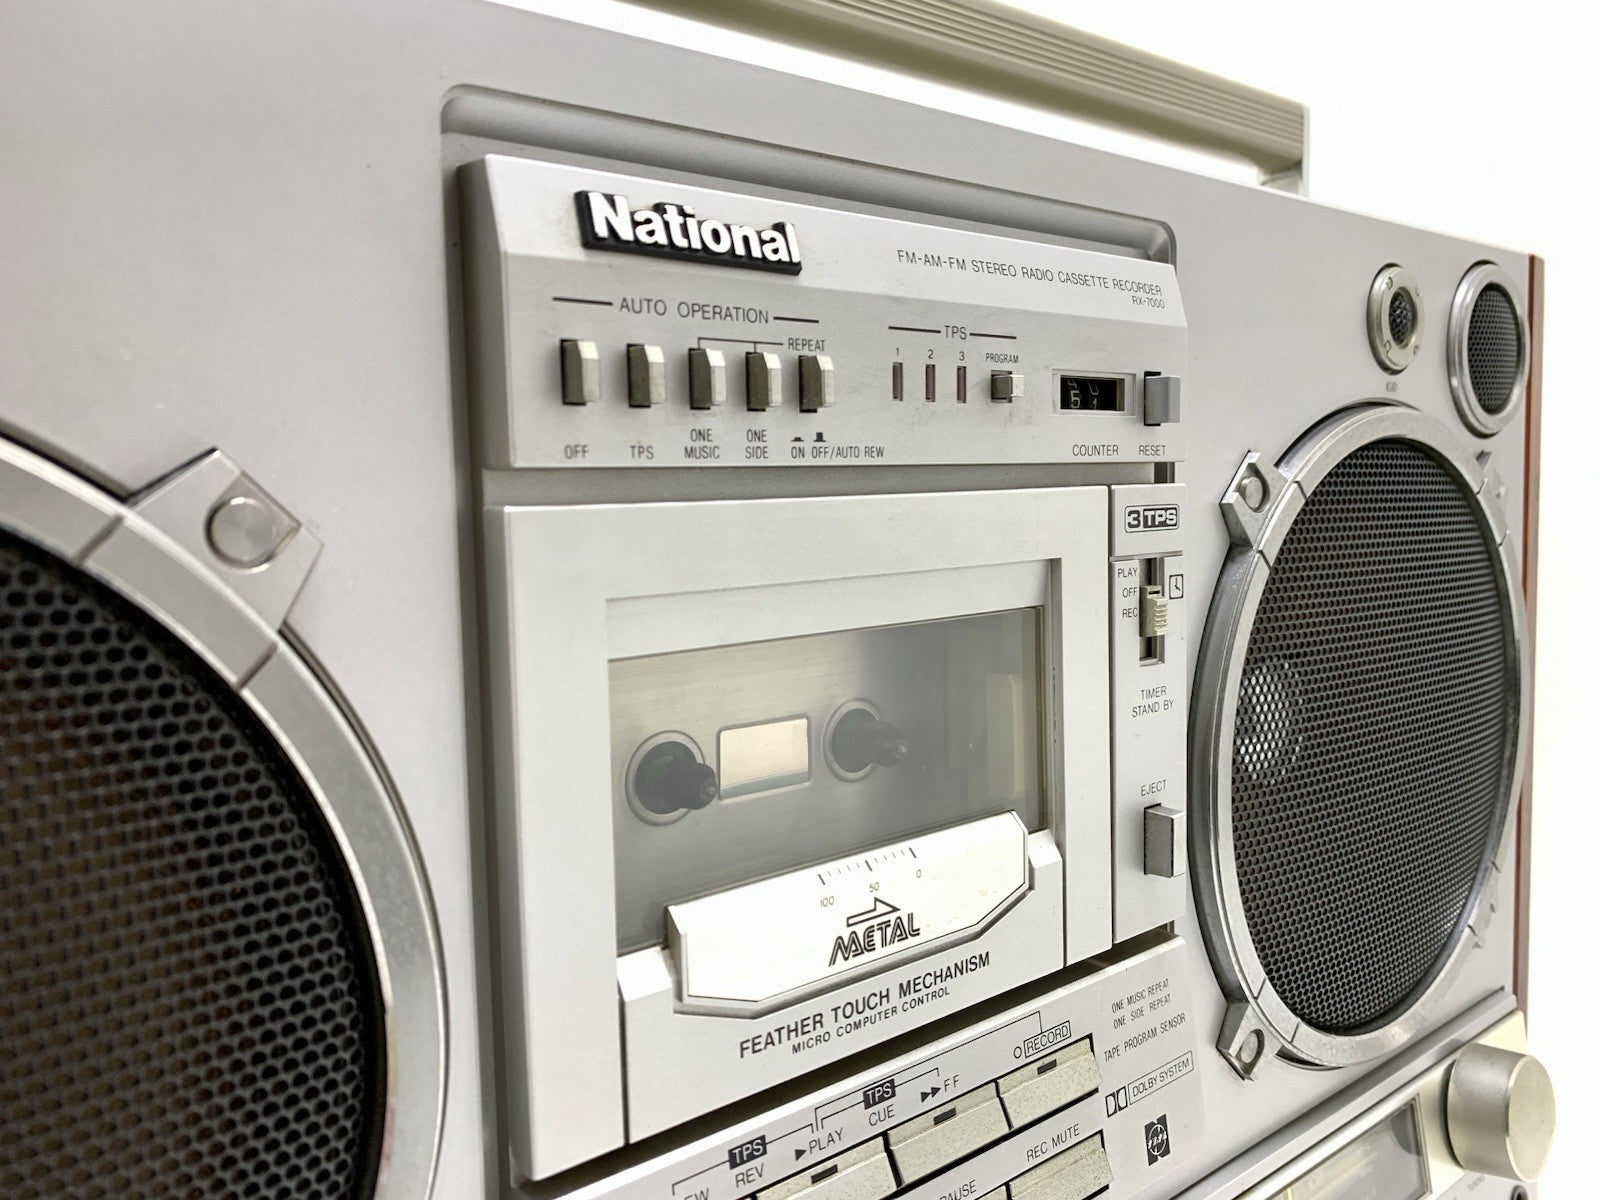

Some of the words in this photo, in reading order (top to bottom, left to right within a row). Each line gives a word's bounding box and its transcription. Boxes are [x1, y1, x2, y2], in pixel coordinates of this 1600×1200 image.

[588, 192, 801, 263] National
[897, 249, 967, 271] FM-AM-FM
[971, 259, 1017, 277] STEREO
[1021, 266, 1054, 282] RADIO
[1057, 271, 1110, 290] CASSETTE
[1112, 278, 1163, 295] RECORDER
[619, 297, 667, 316] AUTO
[676, 301, 769, 325] OPERATION
[1131, 295, 1166, 309] RX-7000
[944, 324, 968, 340] TPS
[787, 337, 826, 352] REPEAT
[895, 347, 900, 357] 1
[927, 349, 934, 360] 2
[958, 351, 966, 362] 3
[985, 352, 1019, 364] PROGRAM
[690, 428, 714, 443] ONE
[746, 429, 768, 443] ONE
[563, 444, 591, 460] OFF
[629, 445, 655, 460] TPS
[684, 445, 721, 460] MUSIC
[744, 446, 769, 460] SIDE
[790, 446, 806, 460] ON
[864, 446, 886, 459] REW
[1071, 444, 1119, 457] COUNTER
[1138, 445, 1166, 457] RESET
[1144, 508, 1177, 526] TPS
[1117, 567, 1138, 579] PLAY
[1122, 587, 1138, 599] OFF
[1122, 608, 1138, 619] REC
[1140, 686, 1167, 701] TIMER
[1131, 704, 1162, 719] STAND
[1163, 700, 1175, 712] BY
[1140, 779, 1168, 797] EJECT
[819, 896, 835, 909] 100
[868, 881, 881, 894] 50
[916, 870, 923, 880] 0
[828, 912, 921, 967] METAL
[739, 1013, 824, 1058] FEATHER
[830, 987, 890, 1024] TOUCH
[899, 950, 991, 999] MECHANISM
[1111, 1002, 1124, 1014] ONE
[1126, 988, 1146, 1005] MUSIC
[1147, 978, 1170, 996] REPEAT
[1113, 1016, 1127, 1030] ONE
[1130, 1007, 1145, 1022] SIDE
[1149, 993, 1171, 1013] REPEAT
[791, 1032, 831, 1055] MICRO
[836, 1007, 899, 1039] COMPUTER
[901, 987, 951, 1014] CONTROL
[1026, 1025, 1069, 1054] RECORD
[1103, 1044, 1121, 1063] TAPE
[1124, 1026, 1158, 1053] PROGRAM
[1160, 1011, 1186, 1034] SENSOR
[1132, 1074, 1159, 1098] DOLBY
[1159, 1056, 1190, 1083] SYSTEM
[864, 1083, 894, 1105] TPS
[868, 1104, 895, 1128] CUE
[809, 1127, 844, 1155] PLAY
[1026, 1142, 1048, 1162] REC
[1052, 1124, 1081, 1149] MUTE
[732, 1142, 764, 1165] TPS
[735, 1163, 765, 1188] REV
